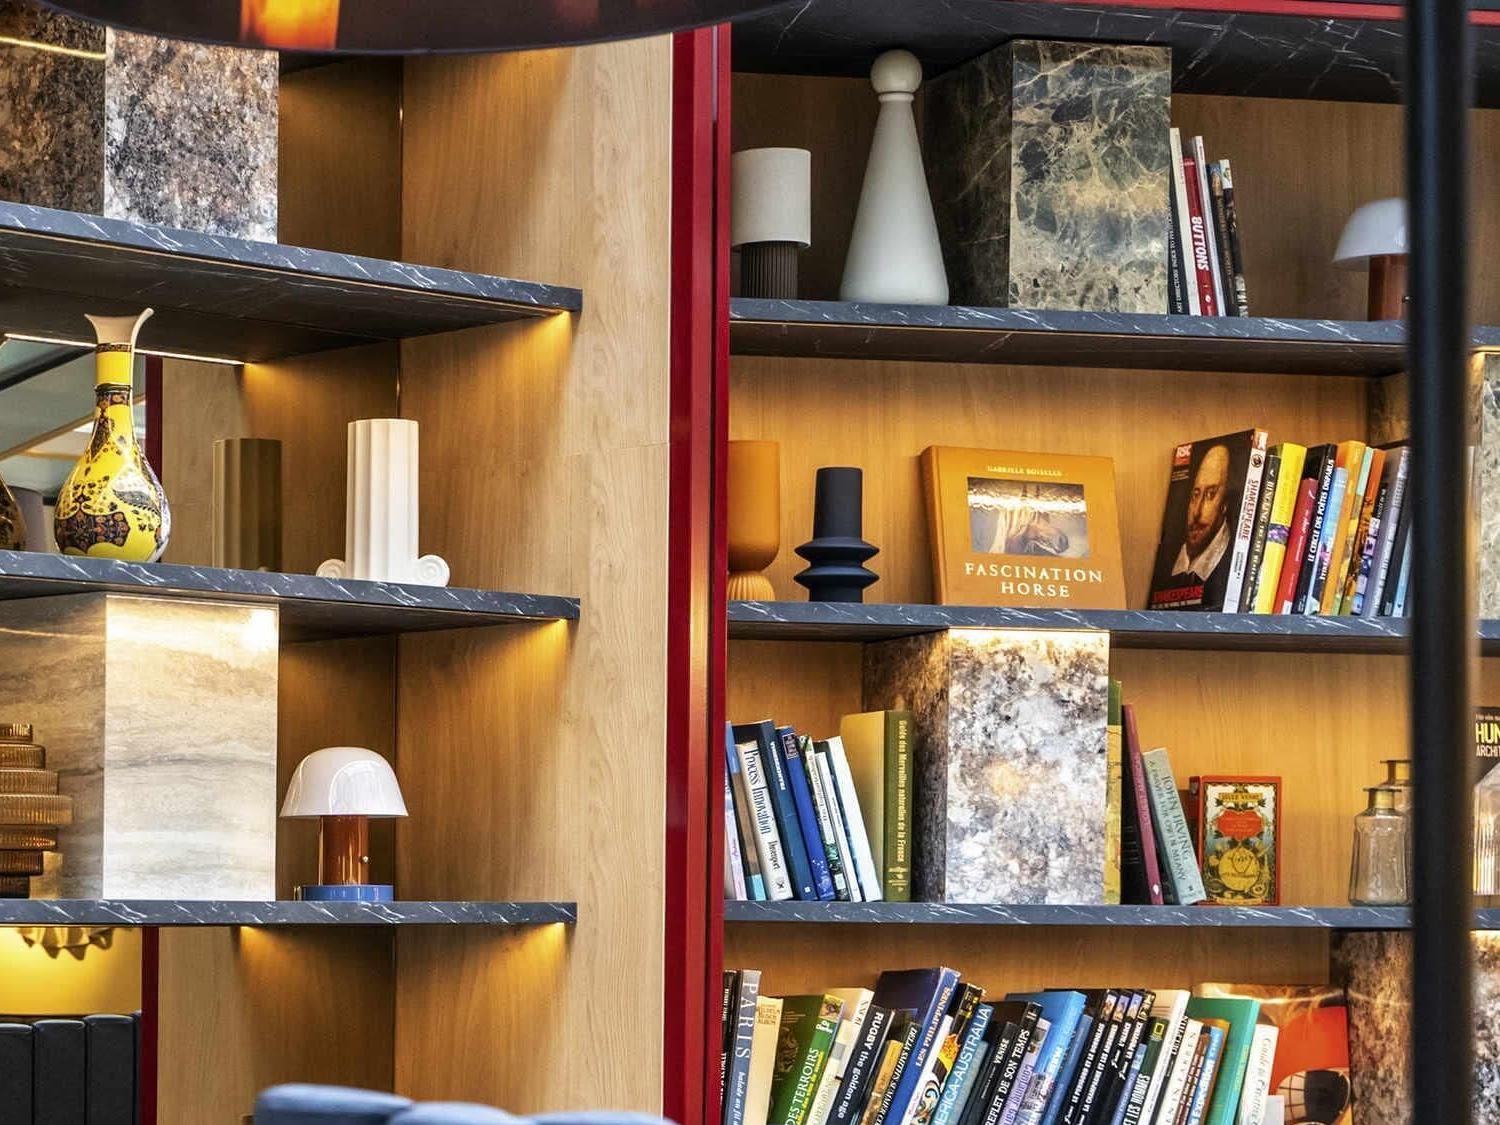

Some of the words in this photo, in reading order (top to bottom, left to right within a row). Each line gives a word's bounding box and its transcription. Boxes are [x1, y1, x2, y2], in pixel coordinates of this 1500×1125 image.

[1191, 216, 1209, 271] BUTTONS
[1320, 458, 1336, 490] DISPARUS
[1241, 480, 1259, 540] SHAKESPEARE
[1313, 515, 1323, 528] DES
[1308, 530, 1320, 553] CERCLE
[965, 562, 1103, 583] FASCINATION
[1001, 582, 1070, 598] HORSE
[899, 721, 907, 739] Guide
[899, 740, 907, 752] des
[898, 754, 907, 787] Merveilles
[744, 749, 760, 786] Process
[752, 787, 772, 835] Innovation
[898, 788, 906, 820] naturelles
[1161, 776, 1178, 810] JOHN
[1172, 814, 1191, 860] IRVING
[897, 839, 906, 862] France
[734, 982, 759, 1059] PARIS
[862, 1011, 884, 1049] RUGBY
[916, 1049, 927, 1068] LES
[924, 986, 951, 1047] PHILIPPINES
[1126, 1020, 1144, 1051] PROVENCE
[1171, 1015, 1188, 1056] DELPHIN
[902, 1026, 918, 1051] DELIA
[995, 1038, 1009, 1064] VENISE
[1012, 1029, 1031, 1059] TEMPS
[794, 1048, 820, 1099] TERROIRS
[856, 1050, 869, 1067] the
[1004, 1060, 1019, 1080] SON
[1084, 1069, 1102, 1104] CHAMPAGNE
[1102, 1023, 1119, 1053] ARDENNES
[842, 1066, 862, 1100] golden
[877, 1080, 898, 1115] SUMMER
[998, 1078, 1011, 1095] DE
[1014, 1064, 1033, 1106] Container
[1129, 1072, 1151, 1104] HOMMES
[1193, 1059, 1215, 1117] Expedition
[835, 1099, 849, 1118] age
[1126, 1103, 1141, 1118] LES
